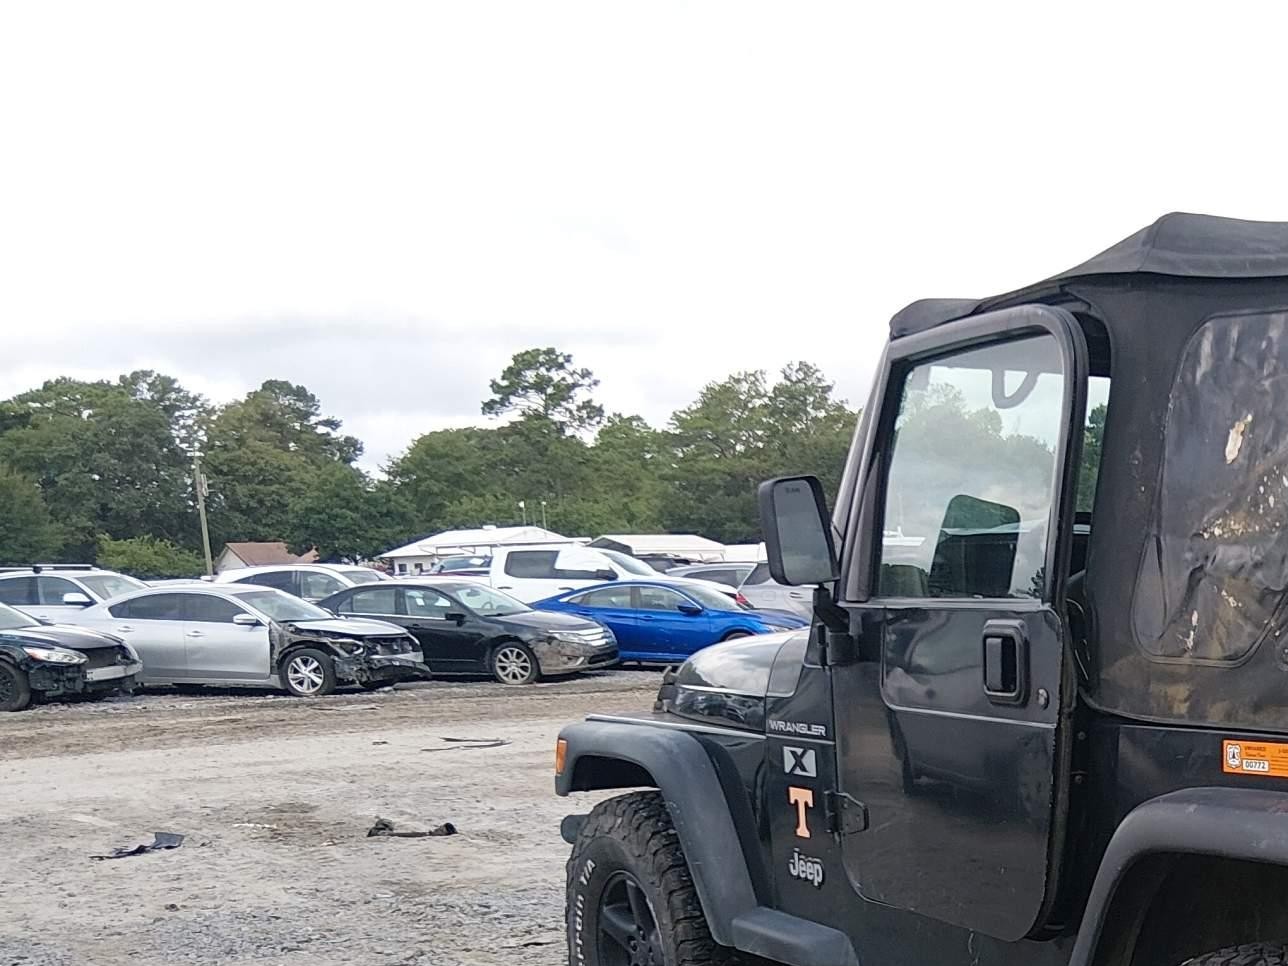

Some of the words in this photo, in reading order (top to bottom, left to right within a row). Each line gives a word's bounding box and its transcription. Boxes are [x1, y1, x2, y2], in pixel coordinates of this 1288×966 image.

[769, 720, 826, 736] WRANGLER
[1245, 761, 1266, 769] 00772
[788, 786, 814, 838] T
[788, 848, 823, 886] Jeep
